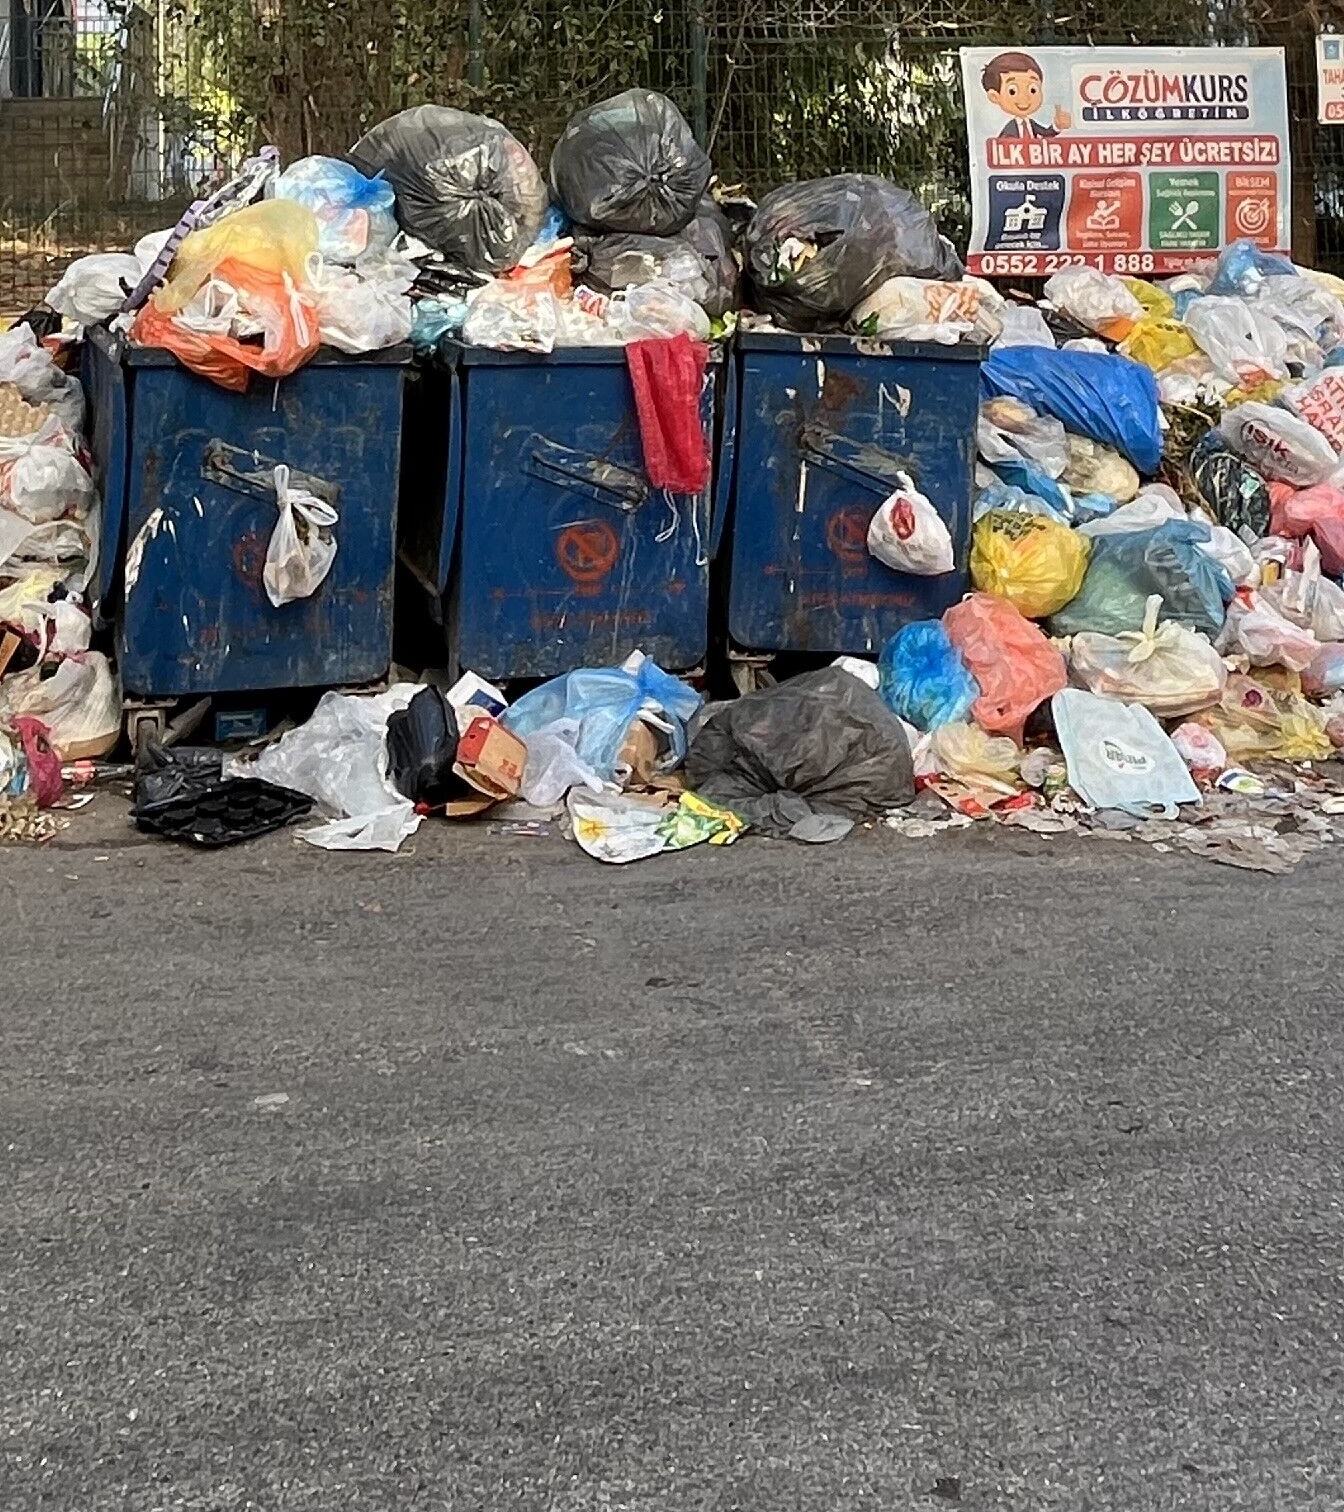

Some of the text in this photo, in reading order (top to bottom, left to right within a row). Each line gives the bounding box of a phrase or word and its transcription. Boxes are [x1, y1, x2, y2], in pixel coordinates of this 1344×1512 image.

[992, 136, 1278, 167] İLK BİR AY HER ŞEY ÜCRETSİZ!
[981, 255, 1038, 274] 0552
[1094, 255, 1104, 273] 1
[1114, 254, 1154, 273] 888
